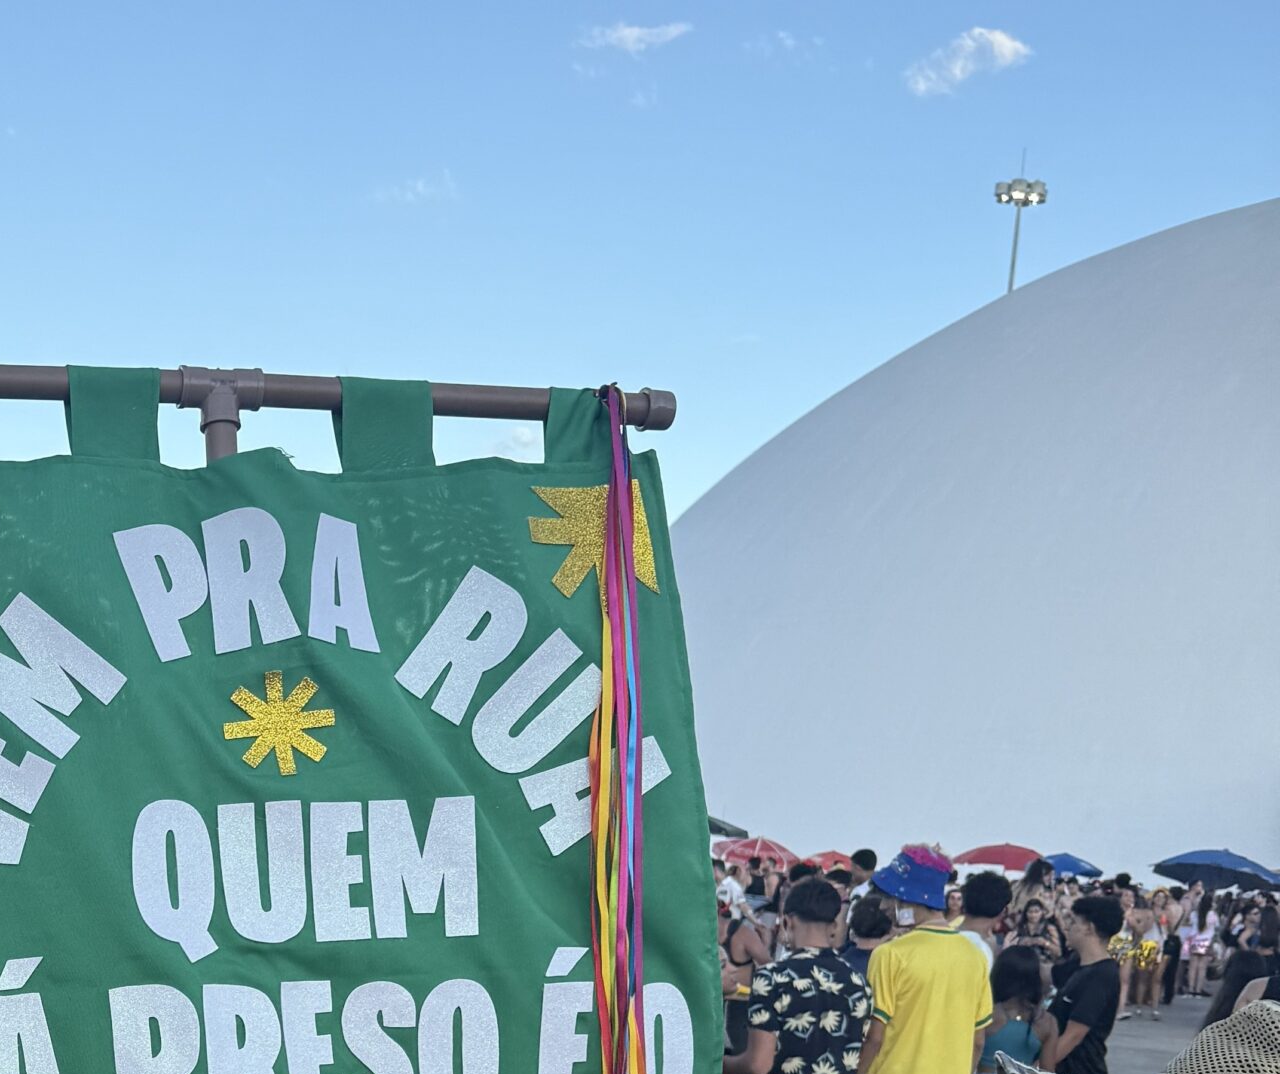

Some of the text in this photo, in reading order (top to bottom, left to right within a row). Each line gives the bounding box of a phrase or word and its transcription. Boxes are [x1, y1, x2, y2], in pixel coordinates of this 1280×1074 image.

[113, 507, 381, 662] PRA
[393, 565, 673, 857] RUA
[131, 796, 480, 964] QUEM
